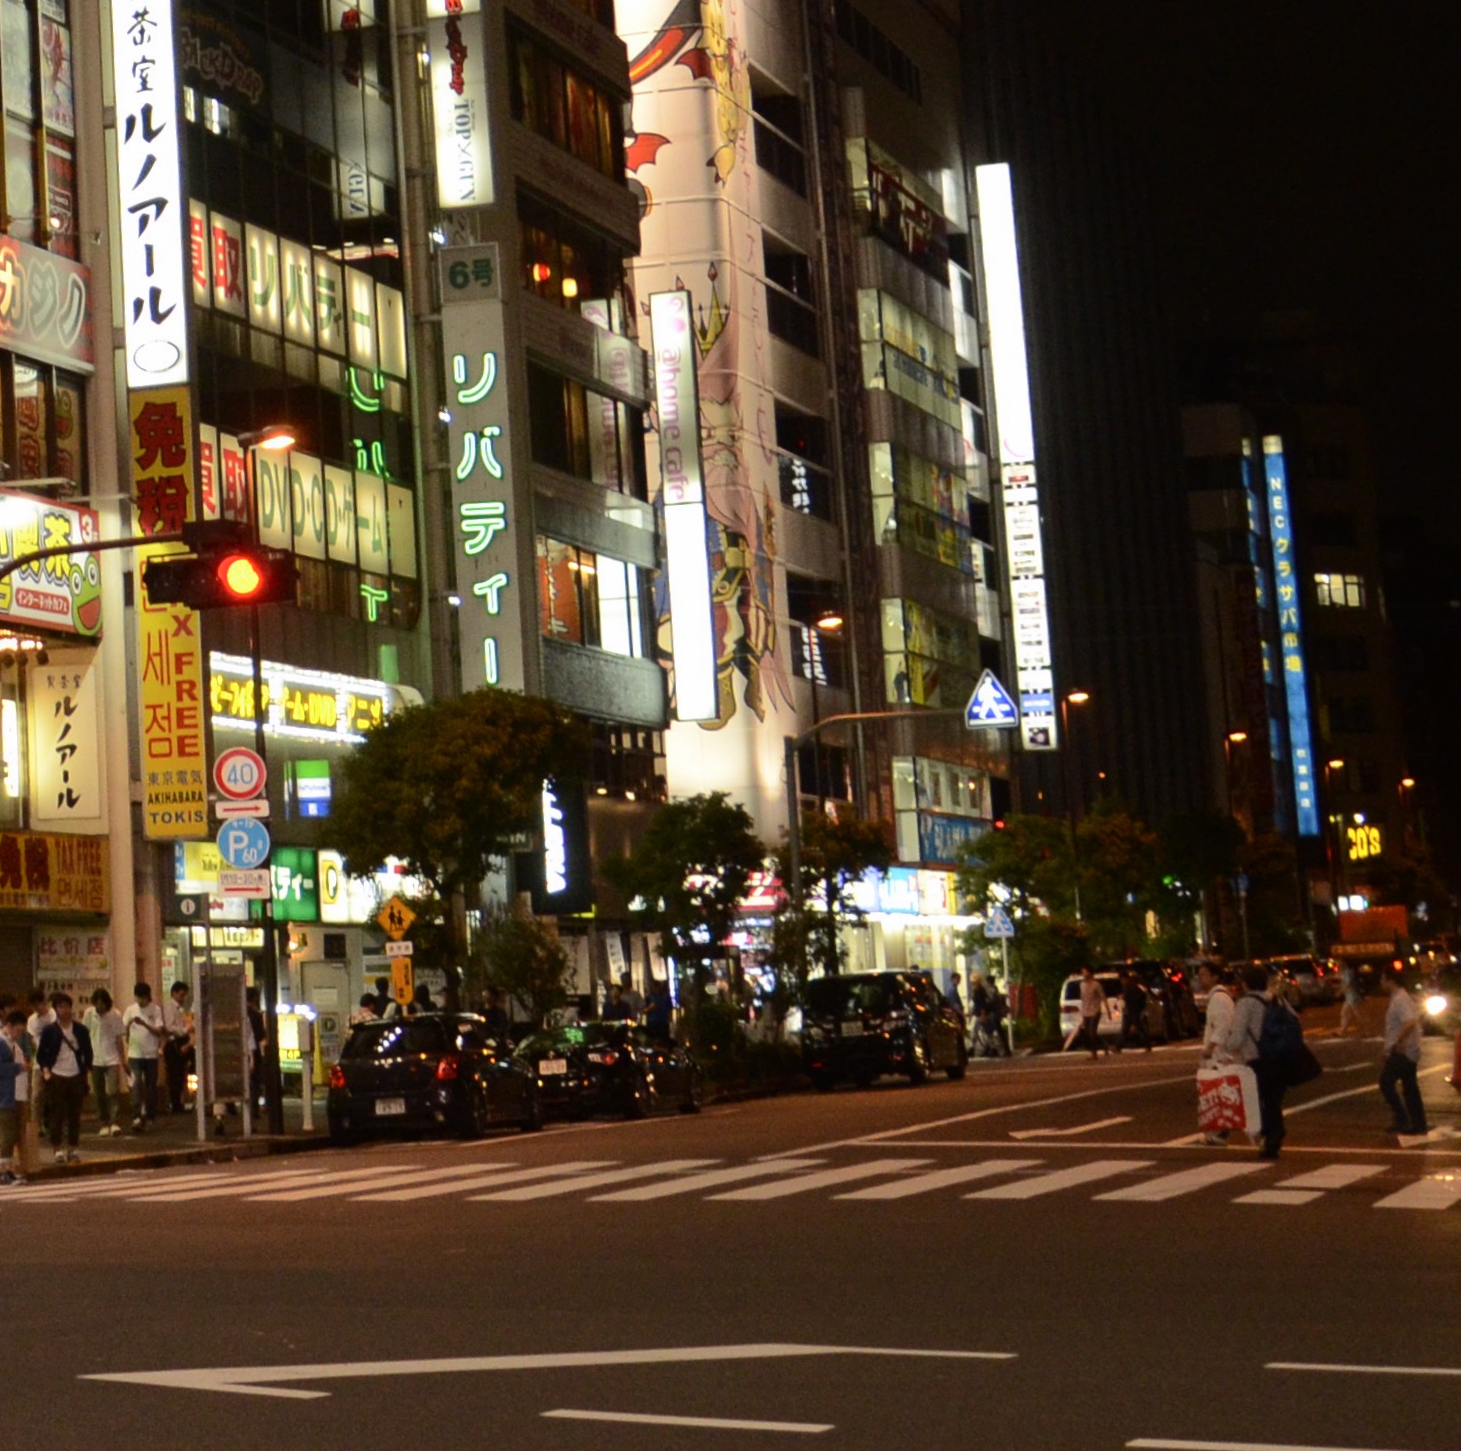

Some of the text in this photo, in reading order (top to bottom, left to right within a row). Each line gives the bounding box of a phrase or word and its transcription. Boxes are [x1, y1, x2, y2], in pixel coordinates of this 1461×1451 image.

[453, 98, 472, 141] TOP
[190, 215, 243, 300] 買取
[133, 399, 192, 535] 免税
[199, 440, 247, 522] 買取
[664, 445, 690, 501] cafe
[451, 351, 508, 684] リバティー
[173, 651, 201, 759] FREE
[53, 694, 81, 810] ルノアール
[226, 762, 255, 786] 40
[147, 790, 204, 805] AKIHABARA
[228, 829, 249, 864] P
